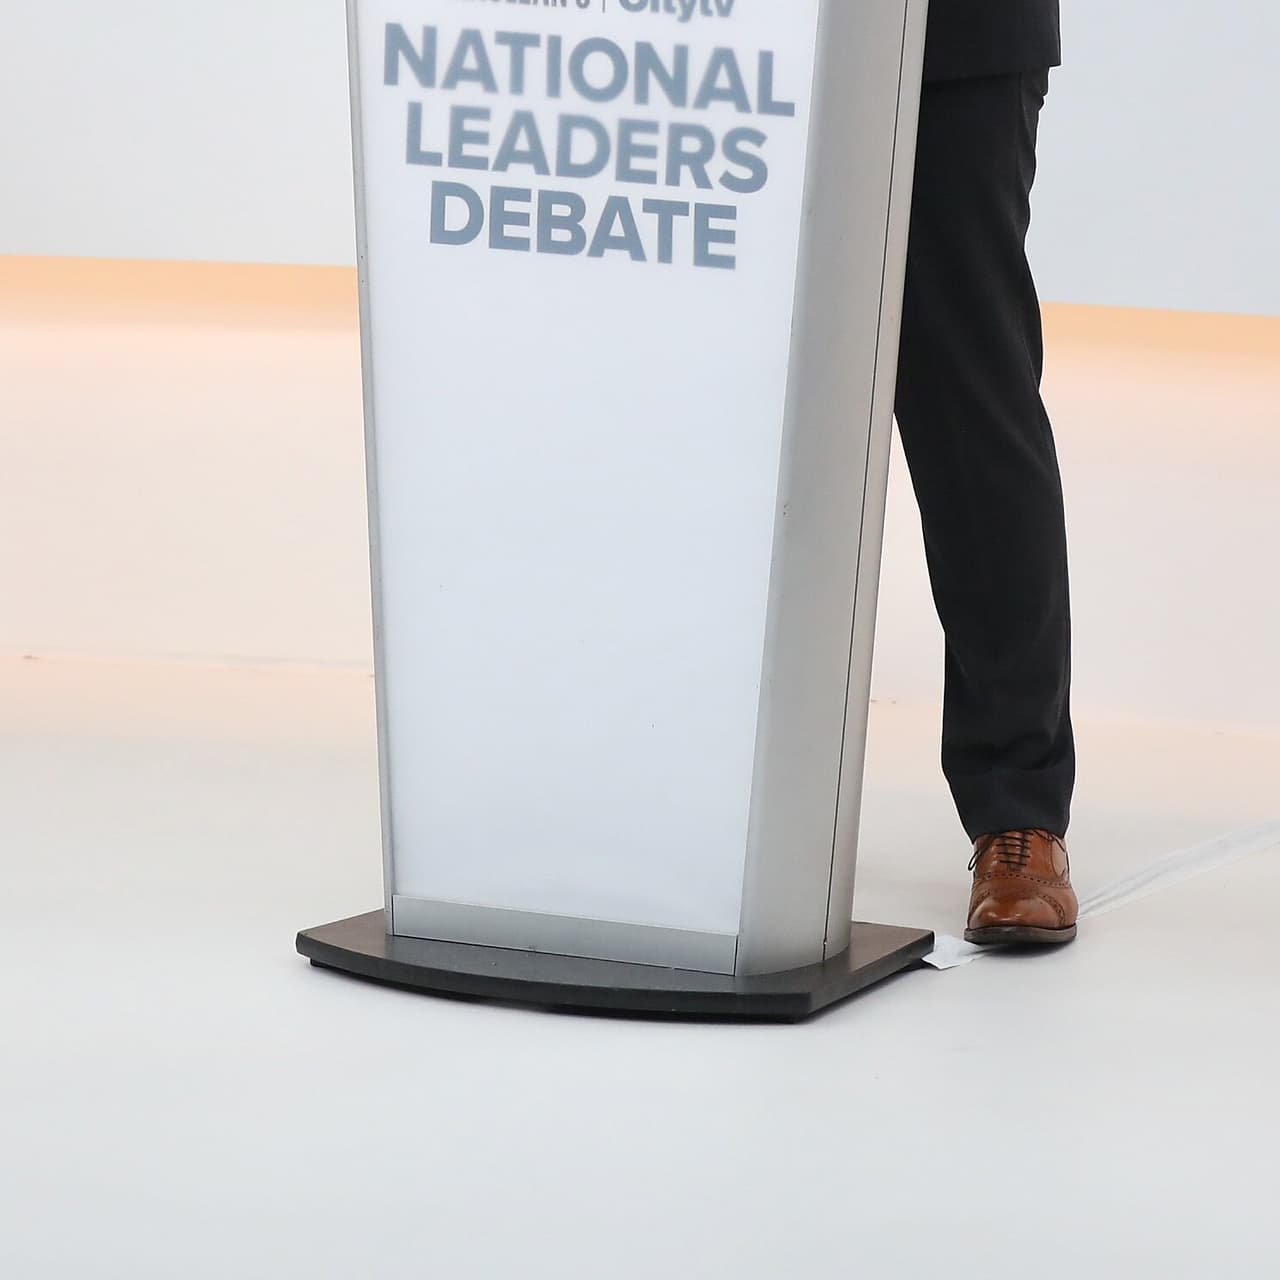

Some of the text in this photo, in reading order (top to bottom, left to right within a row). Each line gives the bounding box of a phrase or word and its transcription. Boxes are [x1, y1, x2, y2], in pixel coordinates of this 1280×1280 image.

[383, 22, 795, 117] NATIONAL
[406, 101, 768, 193] LEADERS
[430, 180, 737, 270] DEBATE
